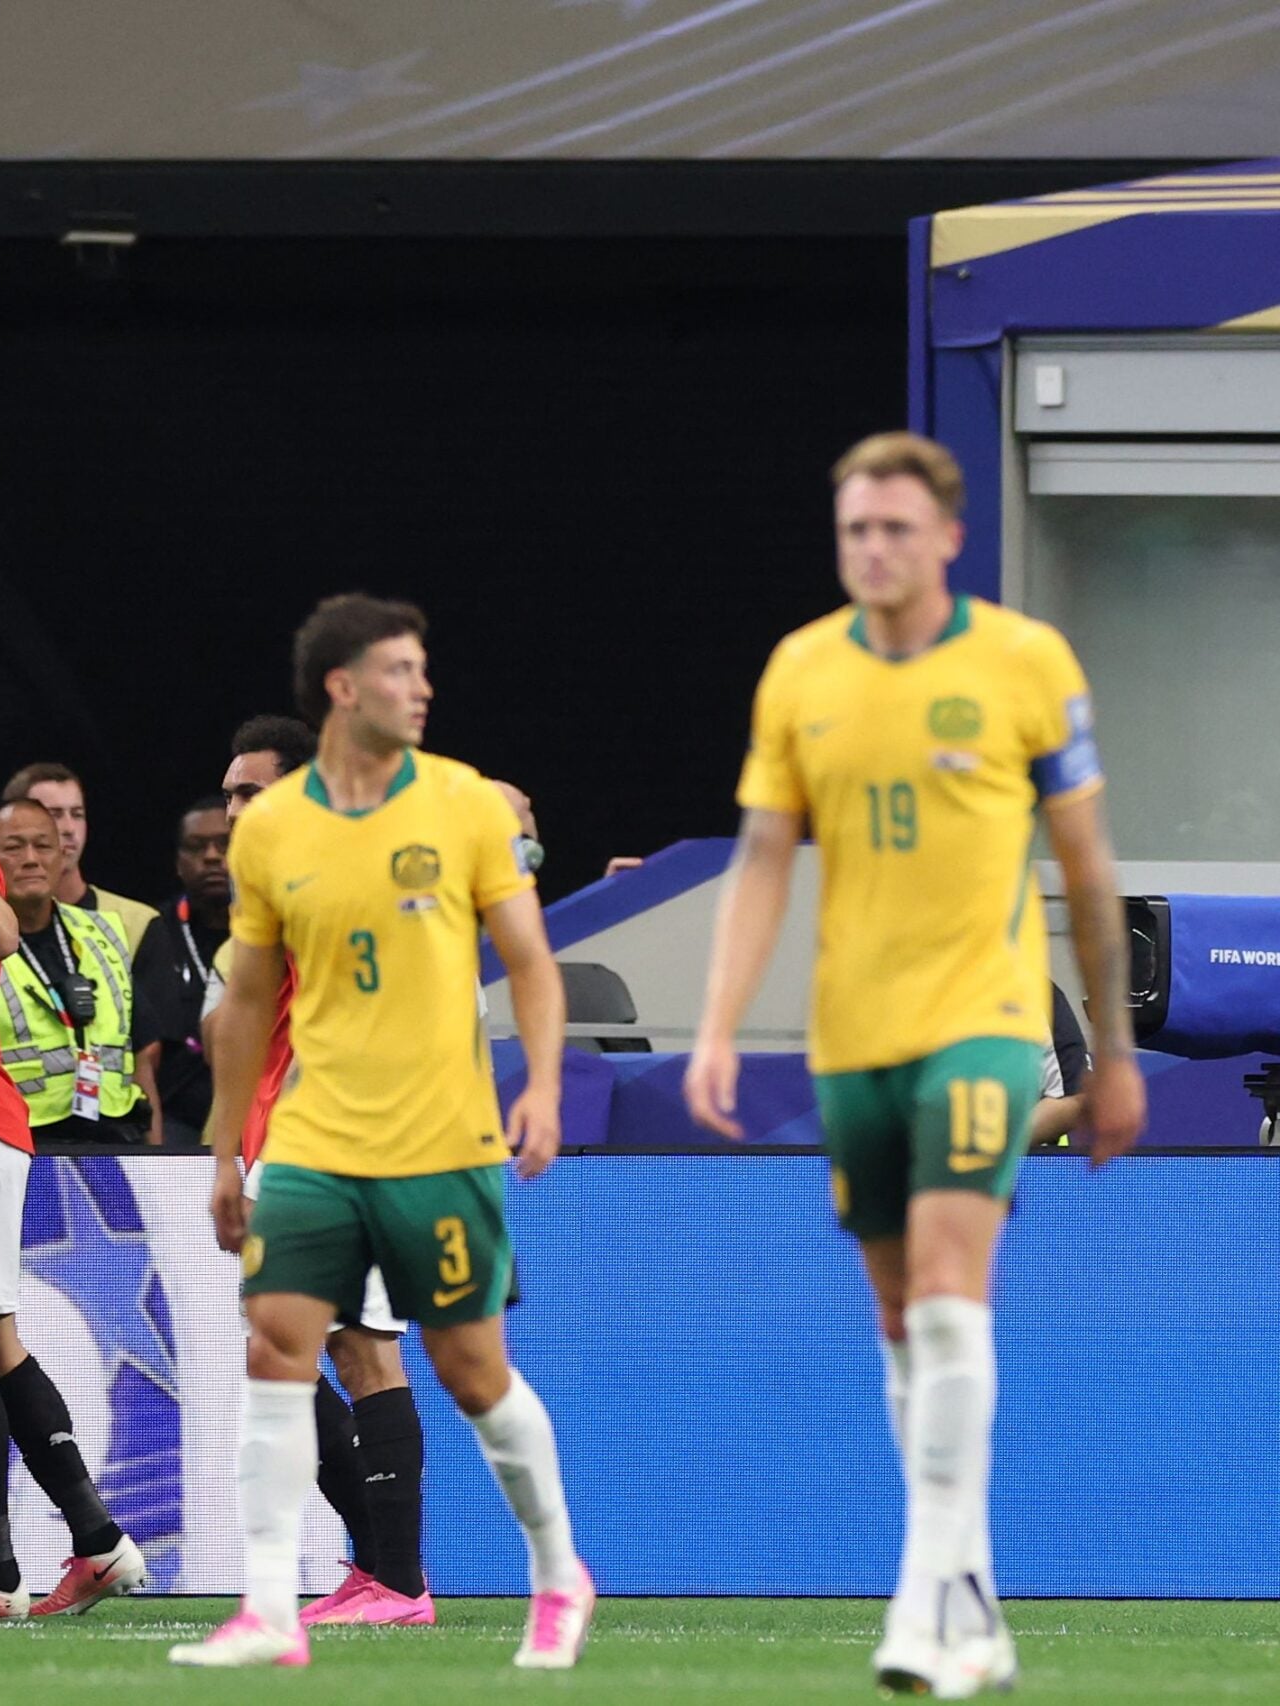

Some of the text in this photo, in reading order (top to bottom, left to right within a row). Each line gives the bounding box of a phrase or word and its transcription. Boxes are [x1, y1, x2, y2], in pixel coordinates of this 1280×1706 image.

[866, 781, 918, 852] 19
[349, 930, 380, 993] 3
[1209, 948, 1241, 964] FIFA
[947, 1077, 1008, 1155] 19
[434, 1215, 471, 1285] 3
